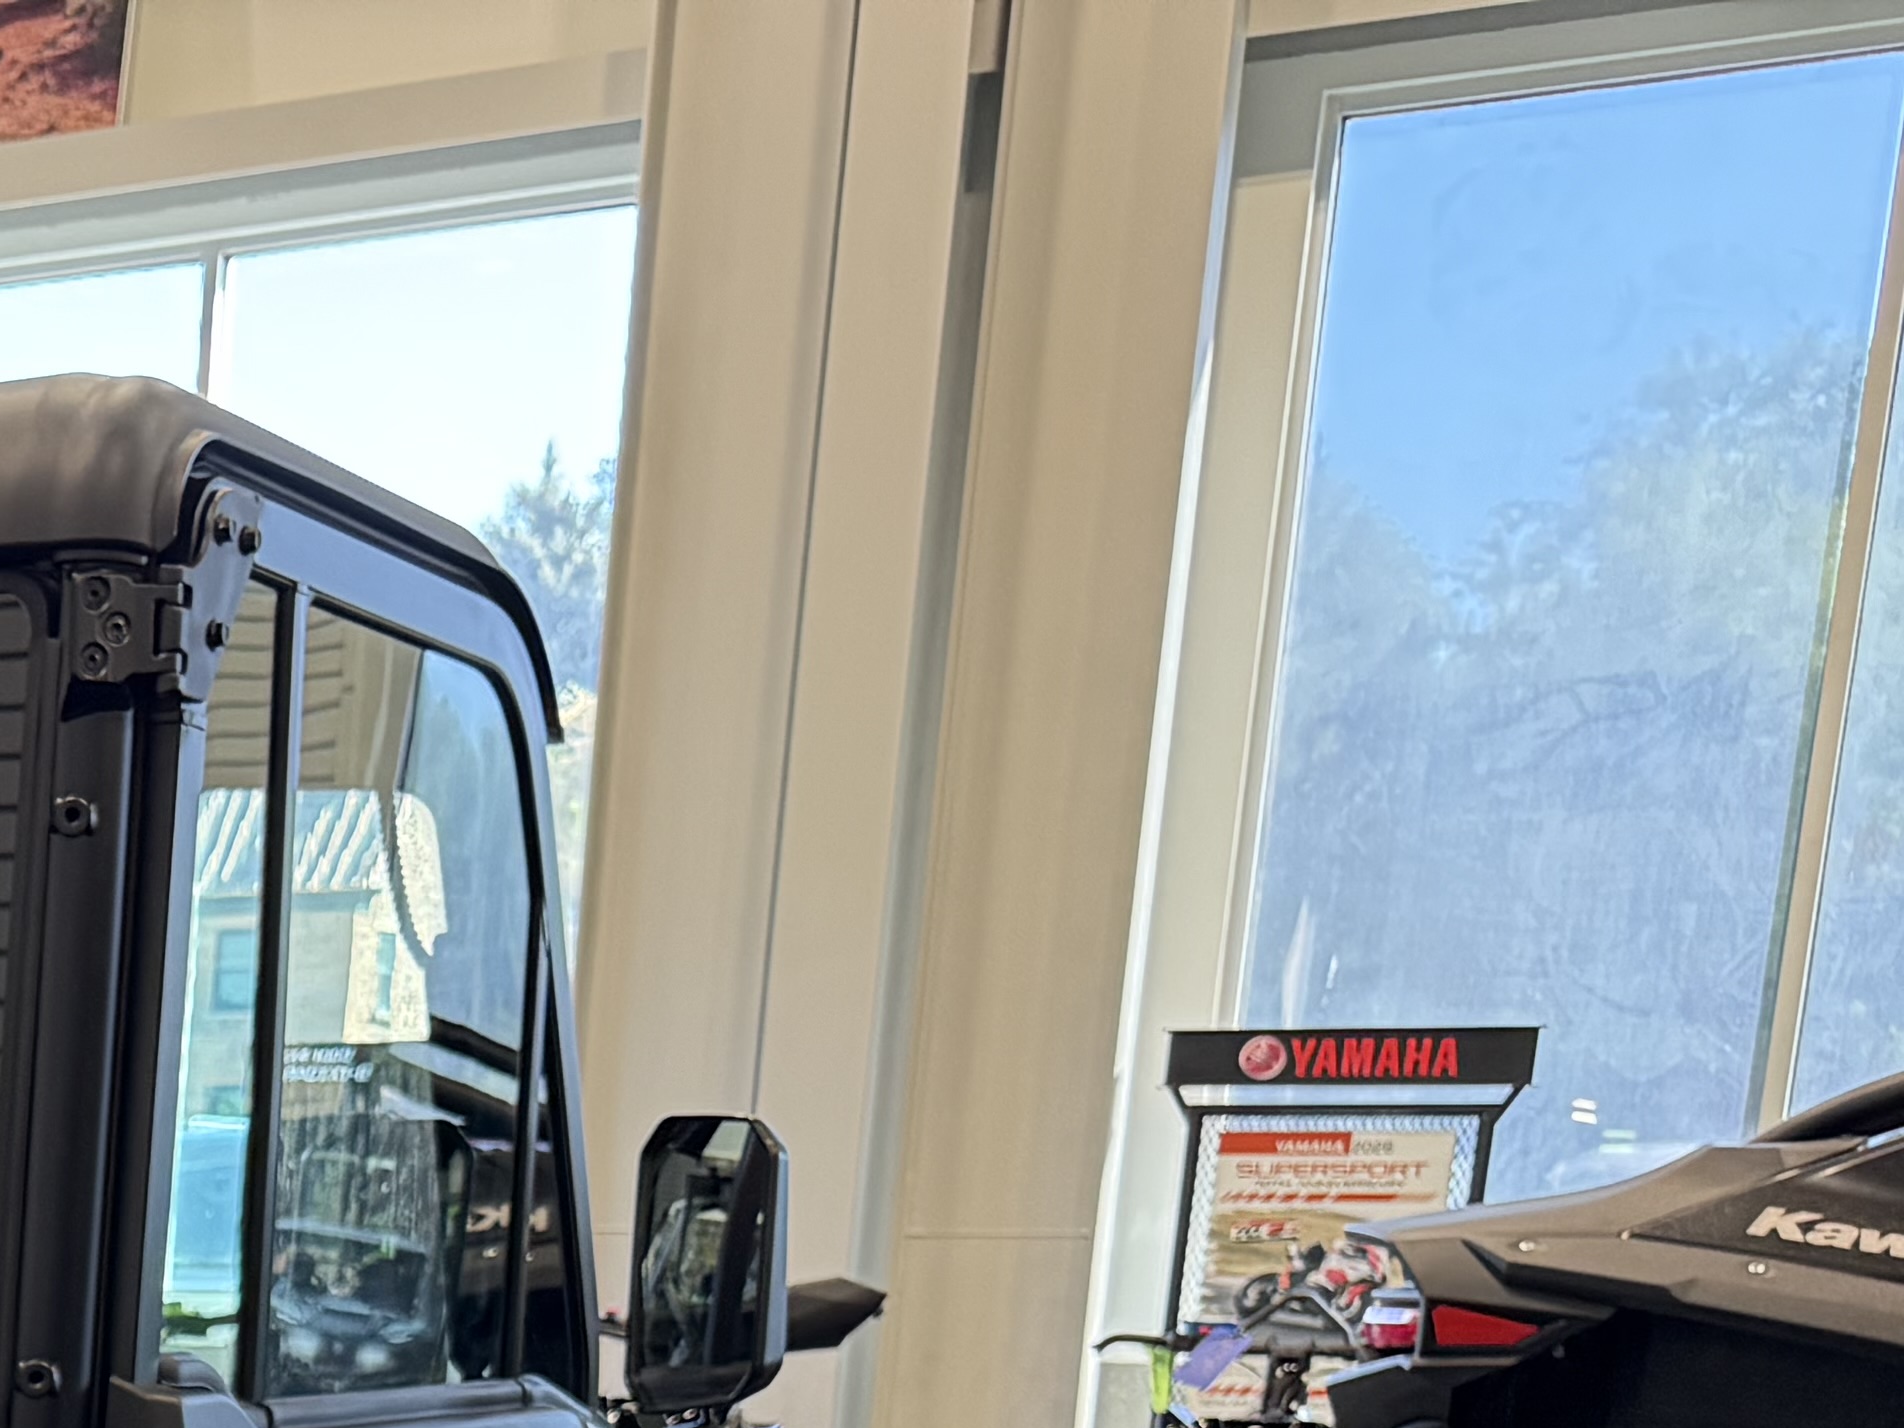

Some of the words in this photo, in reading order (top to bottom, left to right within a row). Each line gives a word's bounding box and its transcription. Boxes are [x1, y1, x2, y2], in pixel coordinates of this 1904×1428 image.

[1290, 1037, 1459, 1079] YAMAHA
[1276, 1140, 1344, 1152] YAMAHA
[1235, 1160, 1429, 1180] SUPERSPORT
